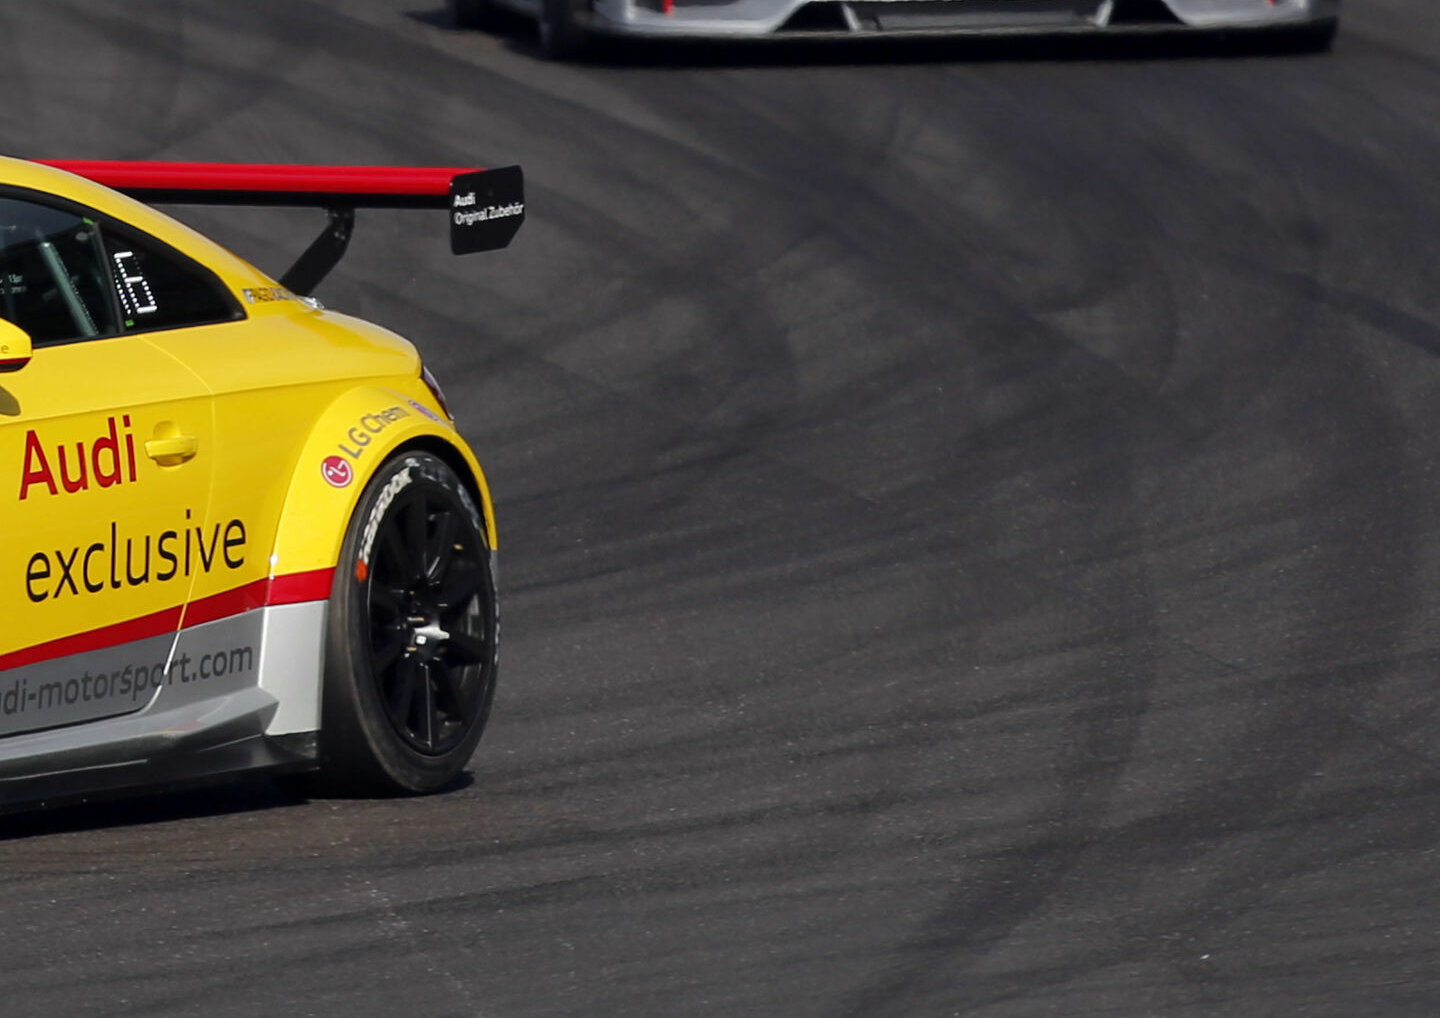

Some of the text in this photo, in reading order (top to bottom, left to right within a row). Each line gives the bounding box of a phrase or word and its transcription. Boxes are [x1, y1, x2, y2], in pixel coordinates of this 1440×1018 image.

[453, 192, 476, 208] Audi
[17, 414, 138, 501] Audi
[338, 405, 411, 459] LG Chem
[24, 509, 248, 603] exclusive
